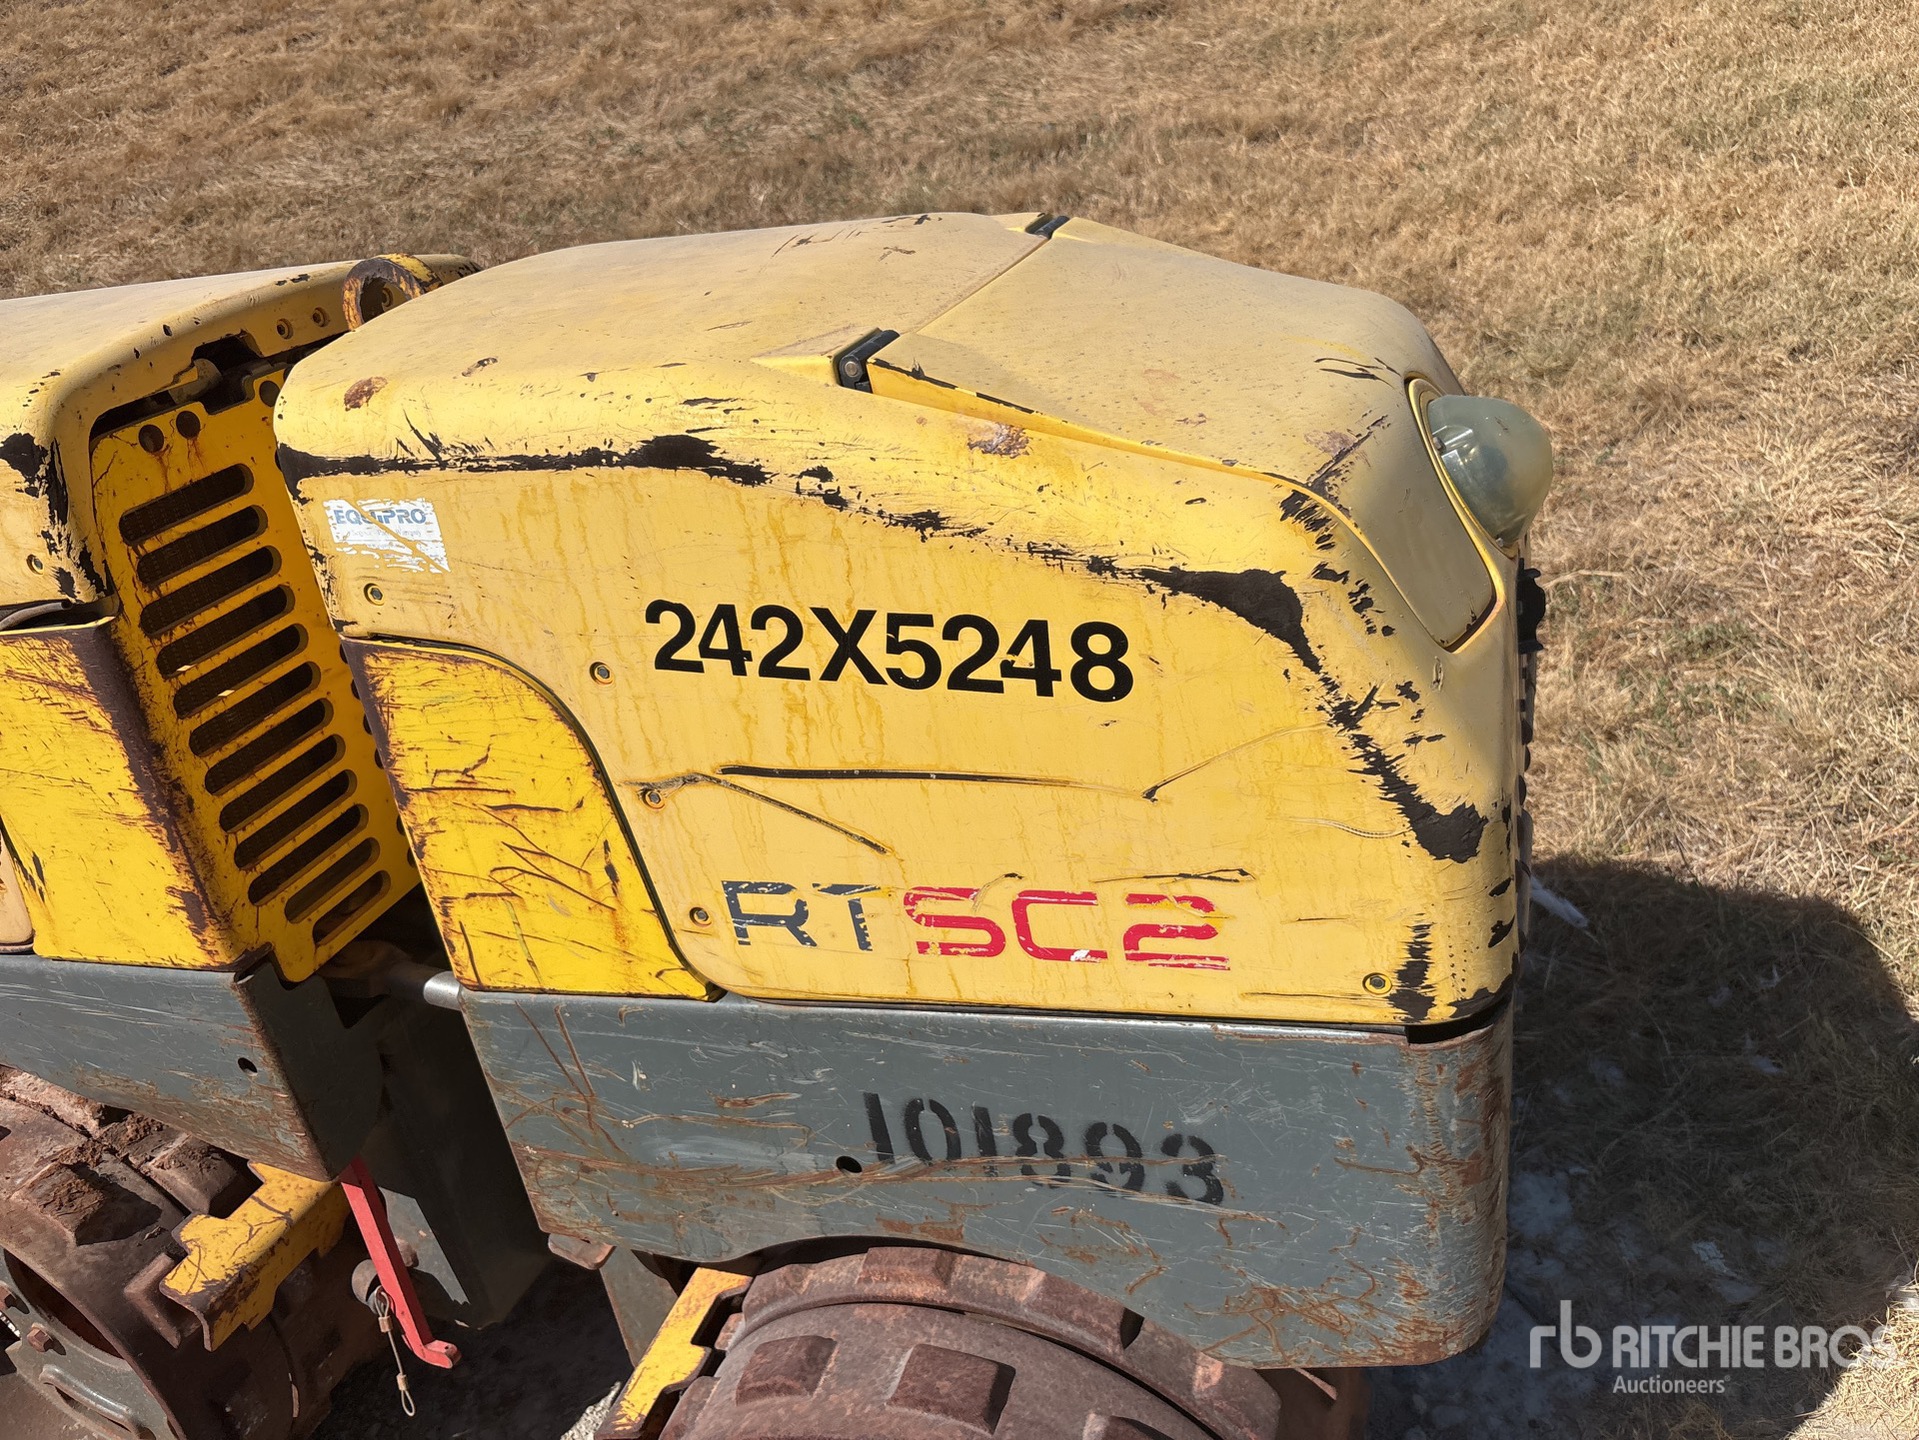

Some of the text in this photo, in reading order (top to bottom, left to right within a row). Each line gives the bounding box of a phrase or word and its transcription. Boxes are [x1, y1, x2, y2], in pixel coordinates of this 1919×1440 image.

[333, 508, 427, 525] EQUIPRO
[645, 599, 1134, 703] 242X5248
[863, 1092, 1225, 1205] 101893
